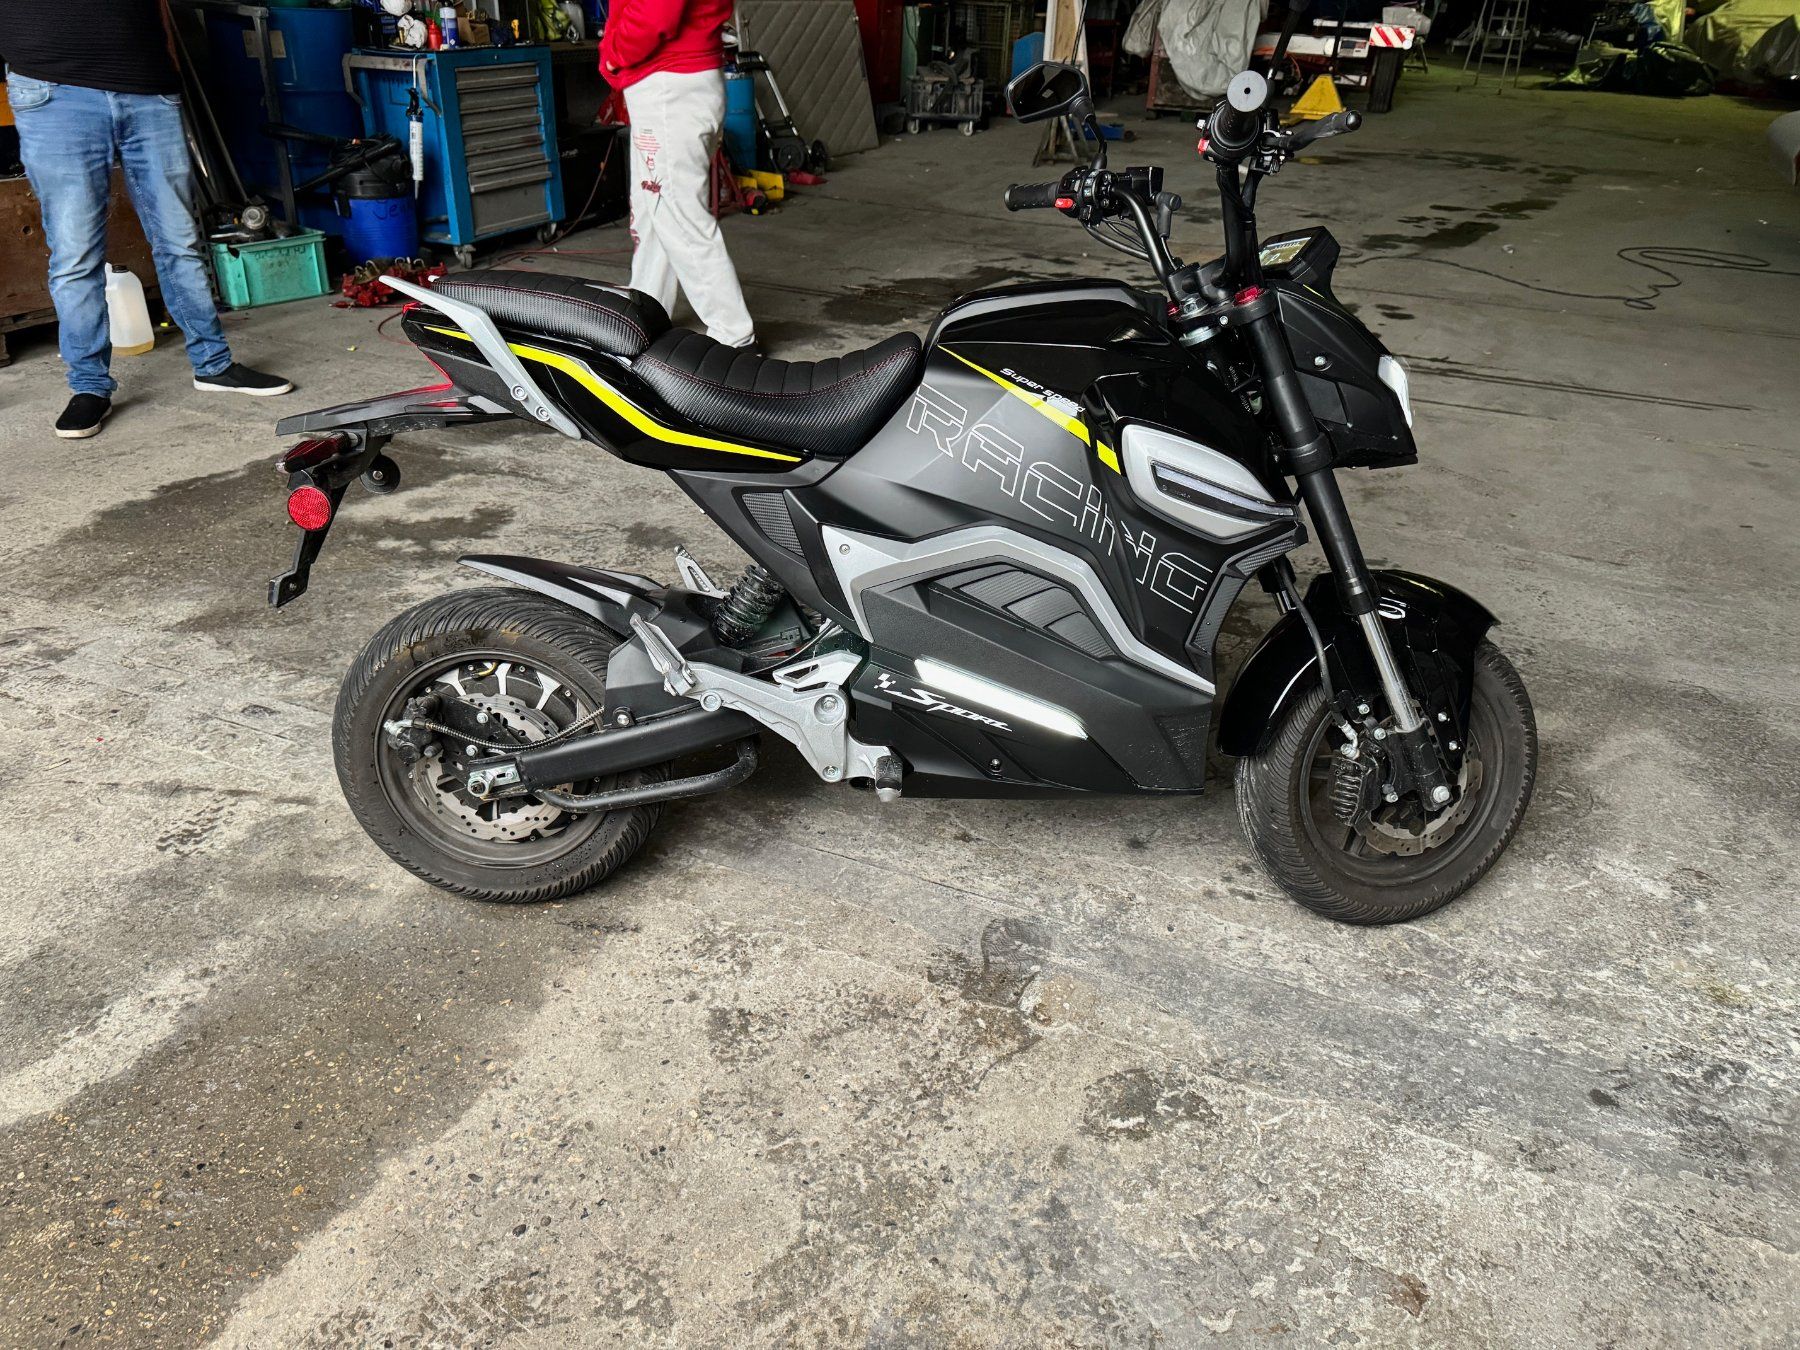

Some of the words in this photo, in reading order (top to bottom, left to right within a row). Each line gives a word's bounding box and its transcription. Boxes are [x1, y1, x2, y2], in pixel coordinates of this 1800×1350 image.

[1000, 367, 1044, 390] Super
[1042, 388, 1086, 413] speed
[906, 382, 1213, 614] RACING
